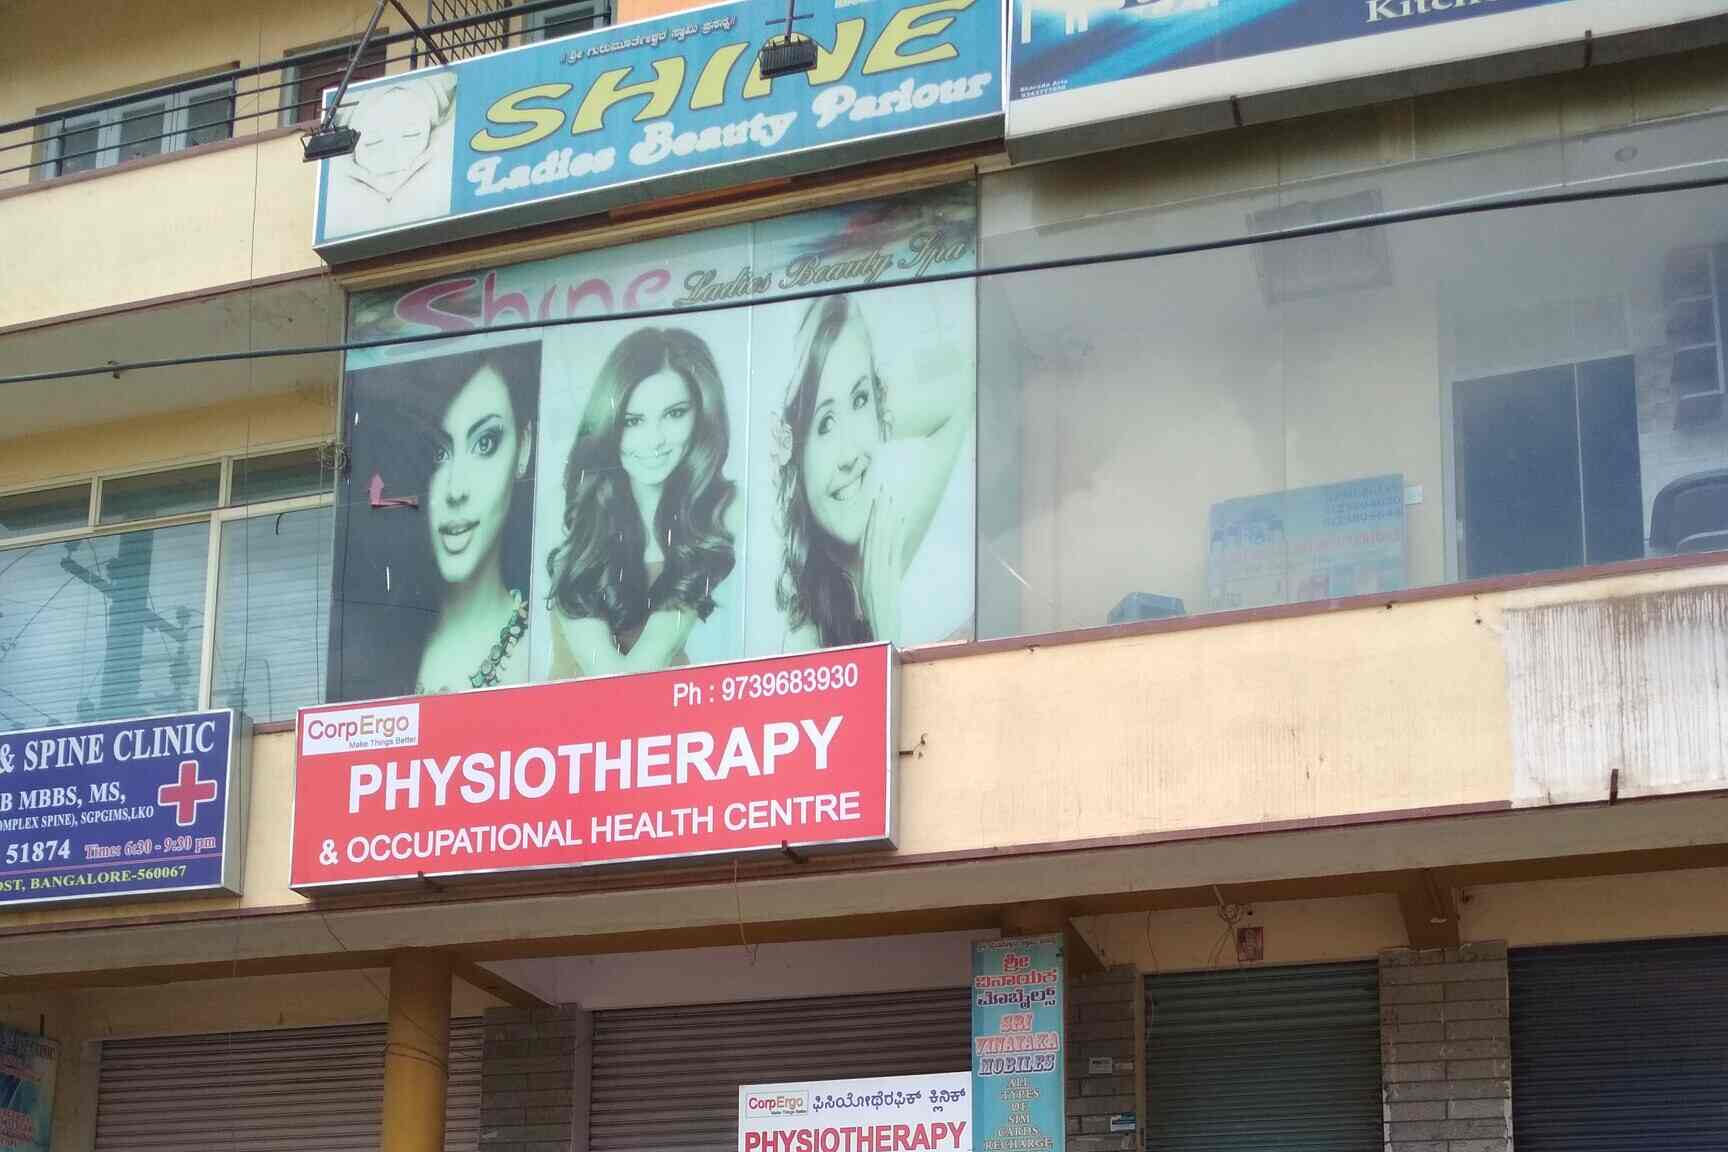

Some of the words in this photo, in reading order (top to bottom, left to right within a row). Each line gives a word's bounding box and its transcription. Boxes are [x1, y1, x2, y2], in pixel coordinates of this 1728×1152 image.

[1365, 0, 1497, 23] Kitc
[469, 0, 976, 152] SHINE
[466, 146, 616, 196] Ladies
[628, 110, 798, 166] Beauty
[812, 72, 992, 129] Parlour
[673, 266, 772, 308] Ladies
[779, 249, 893, 291] Beauty
[897, 230, 966, 279] Spa
[672, 679, 703, 709] Ph
[721, 663, 859, 702] 9739683930
[308, 715, 410, 742] CorpErgo
[349, 740, 369, 749] Make
[370, 739, 394, 748] Things
[395, 736, 417, 745] Better
[0, 743, 16, 774] &
[23, 733, 104, 772] SPINE
[113, 720, 216, 762] CLINIC
[347, 714, 845, 815] PHYSIOTHERAPY
[18, 786, 83, 810] MBBS,
[89, 782, 126, 804] MS,
[80, 805, 155, 825] SGPGIMS,LKO
[319, 839, 339, 865] &
[345, 817, 582, 864] OCCUPATIONAL
[590, 806, 715, 843] HEALTH
[724, 791, 861, 830] CENTRE
[6, 839, 71, 864] 51874
[124, 839, 153, 856] 6:30
[163, 835, 193, 853] 9:30
[195, 836, 216, 853] pm
[30, 865, 187, 890] BANGALORE-560067
[978, 1054, 1056, 1076] MOBILES
[749, 1095, 803, 1111] CorpErgo
[1008, 1113, 1030, 1124] SIM
